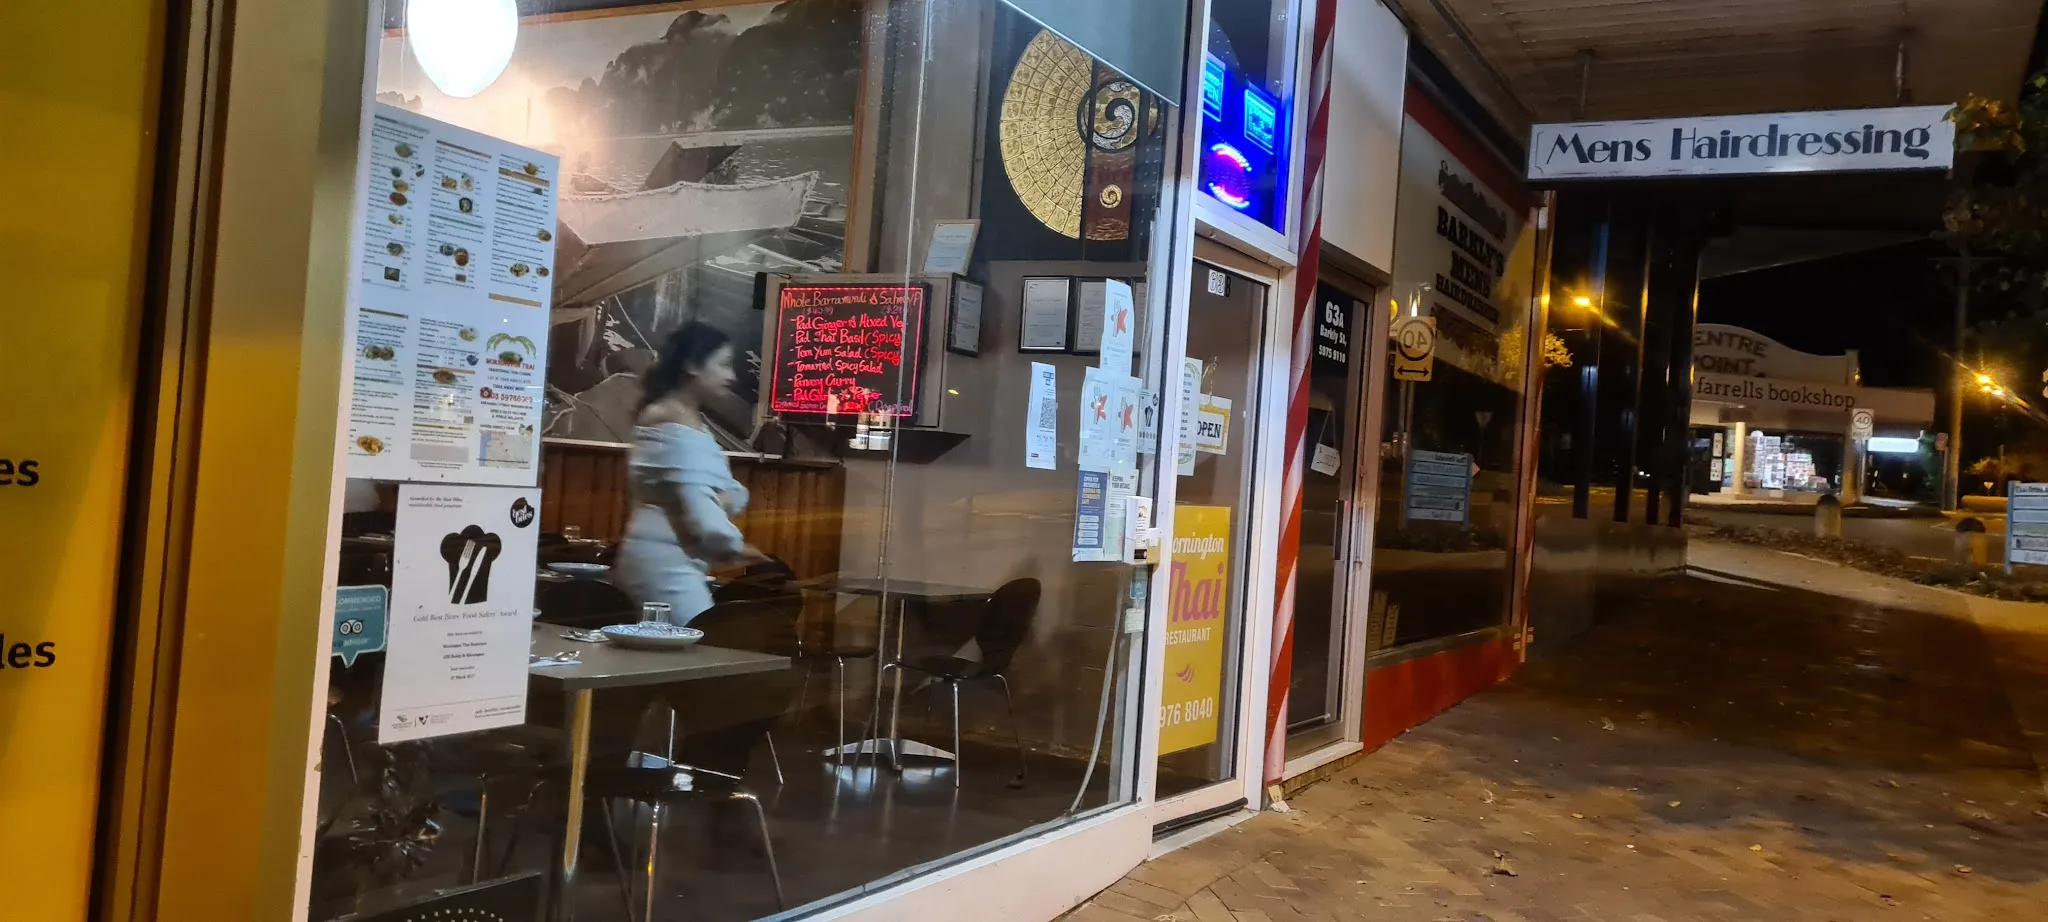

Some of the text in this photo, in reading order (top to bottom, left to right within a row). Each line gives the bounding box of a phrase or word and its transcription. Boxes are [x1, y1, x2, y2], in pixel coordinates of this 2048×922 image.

[1546, 123, 1932, 166] Mens Hairdressing
[1325, 301, 1344, 328] 63A
[1697, 376, 1856, 412] farrells bookshop
[1172, 532, 1224, 560] ornington
[1165, 627, 1211, 645] RESTAURANT
[1160, 697, 1214, 728] 976 8040
